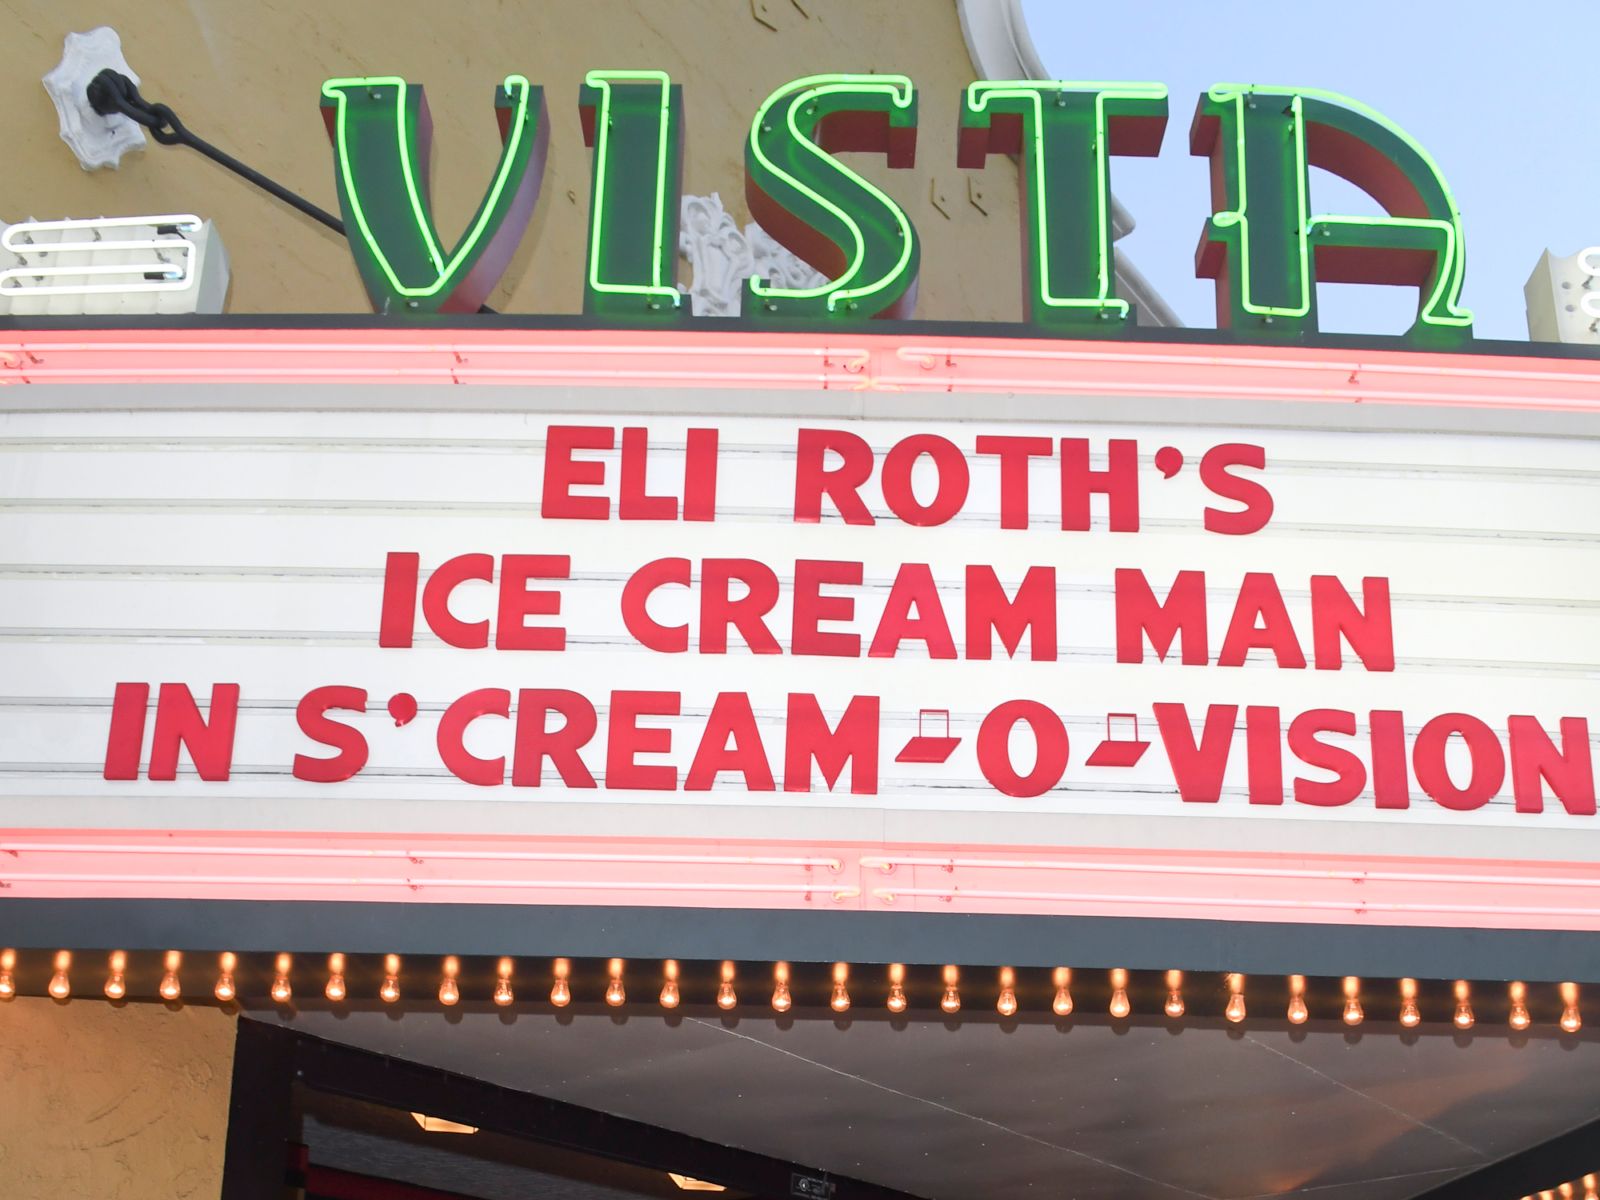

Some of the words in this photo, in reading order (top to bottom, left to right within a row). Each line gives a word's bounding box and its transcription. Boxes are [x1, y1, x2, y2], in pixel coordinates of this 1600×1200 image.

[320, 70, 1473, 340] VISTA
[541, 425, 719, 522] ELI
[793, 428, 1275, 536] ROTH'S
[379, 552, 571, 651] ICE
[621, 557, 1058, 662] CREAM
[1114, 568, 1396, 672] MAN
[104, 682, 240, 782] IN
